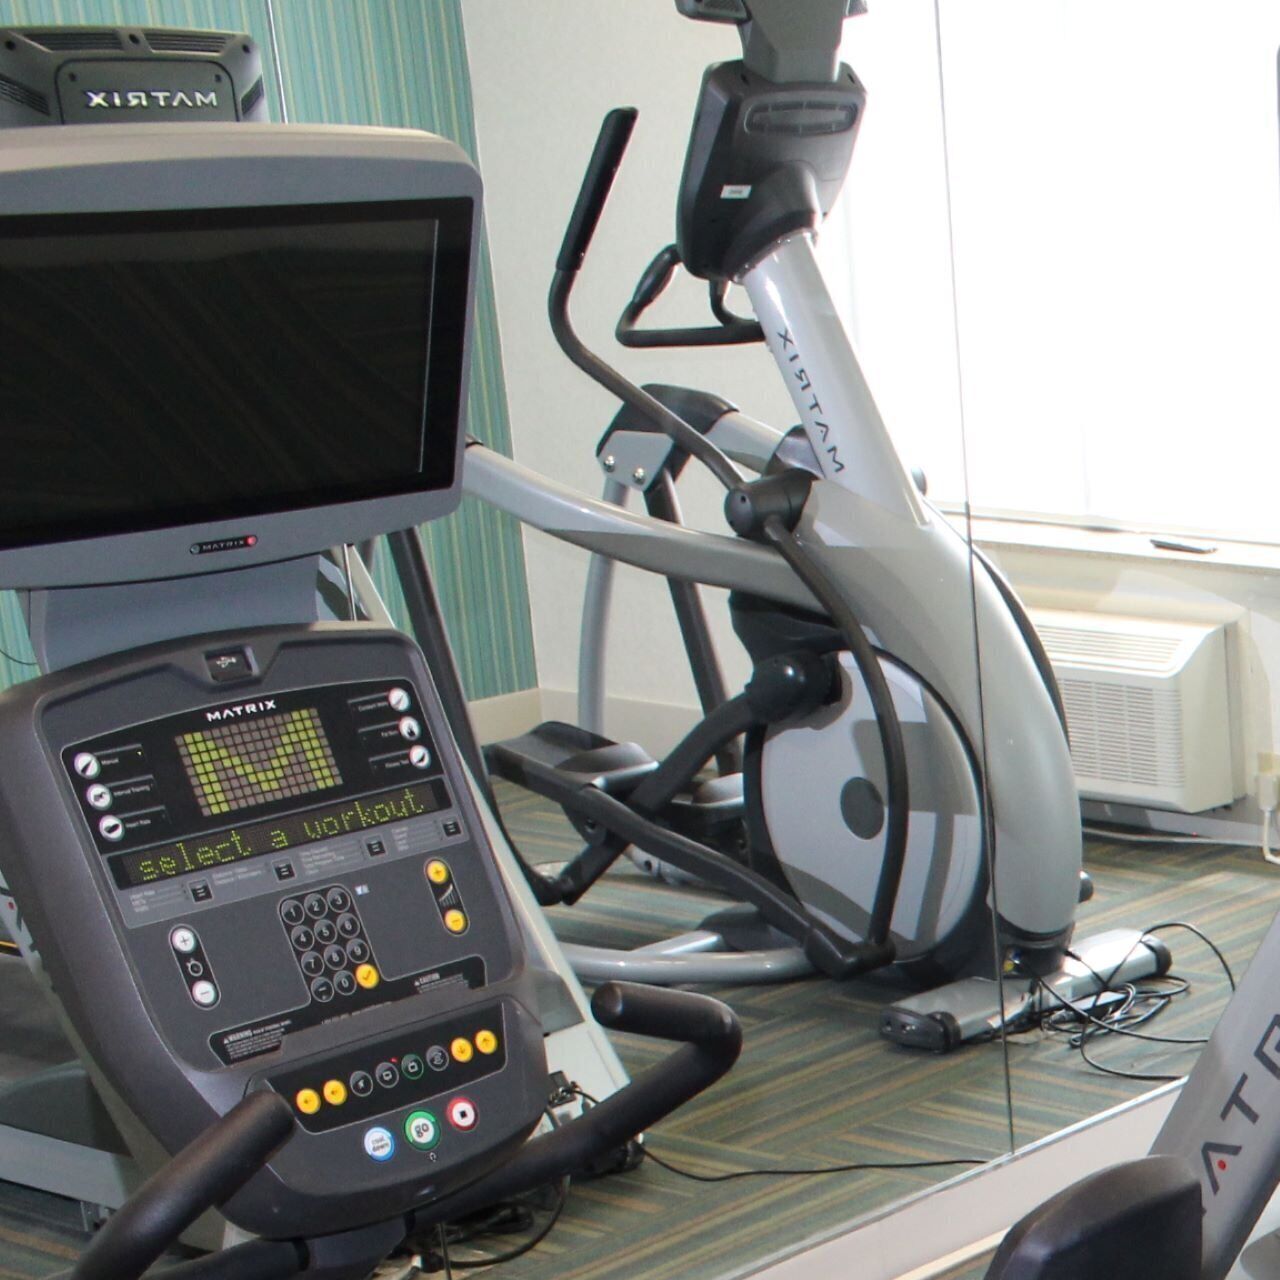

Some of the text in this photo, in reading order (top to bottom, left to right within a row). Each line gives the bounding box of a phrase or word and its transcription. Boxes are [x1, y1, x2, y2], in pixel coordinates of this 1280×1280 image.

[206, 700, 276, 722] MATRIX
[139, 829, 252, 881] select
[269, 828, 290, 849] a
[303, 788, 424, 840] workout
[312, 901, 319, 911] 2
[414, 1122, 429, 1138] go
